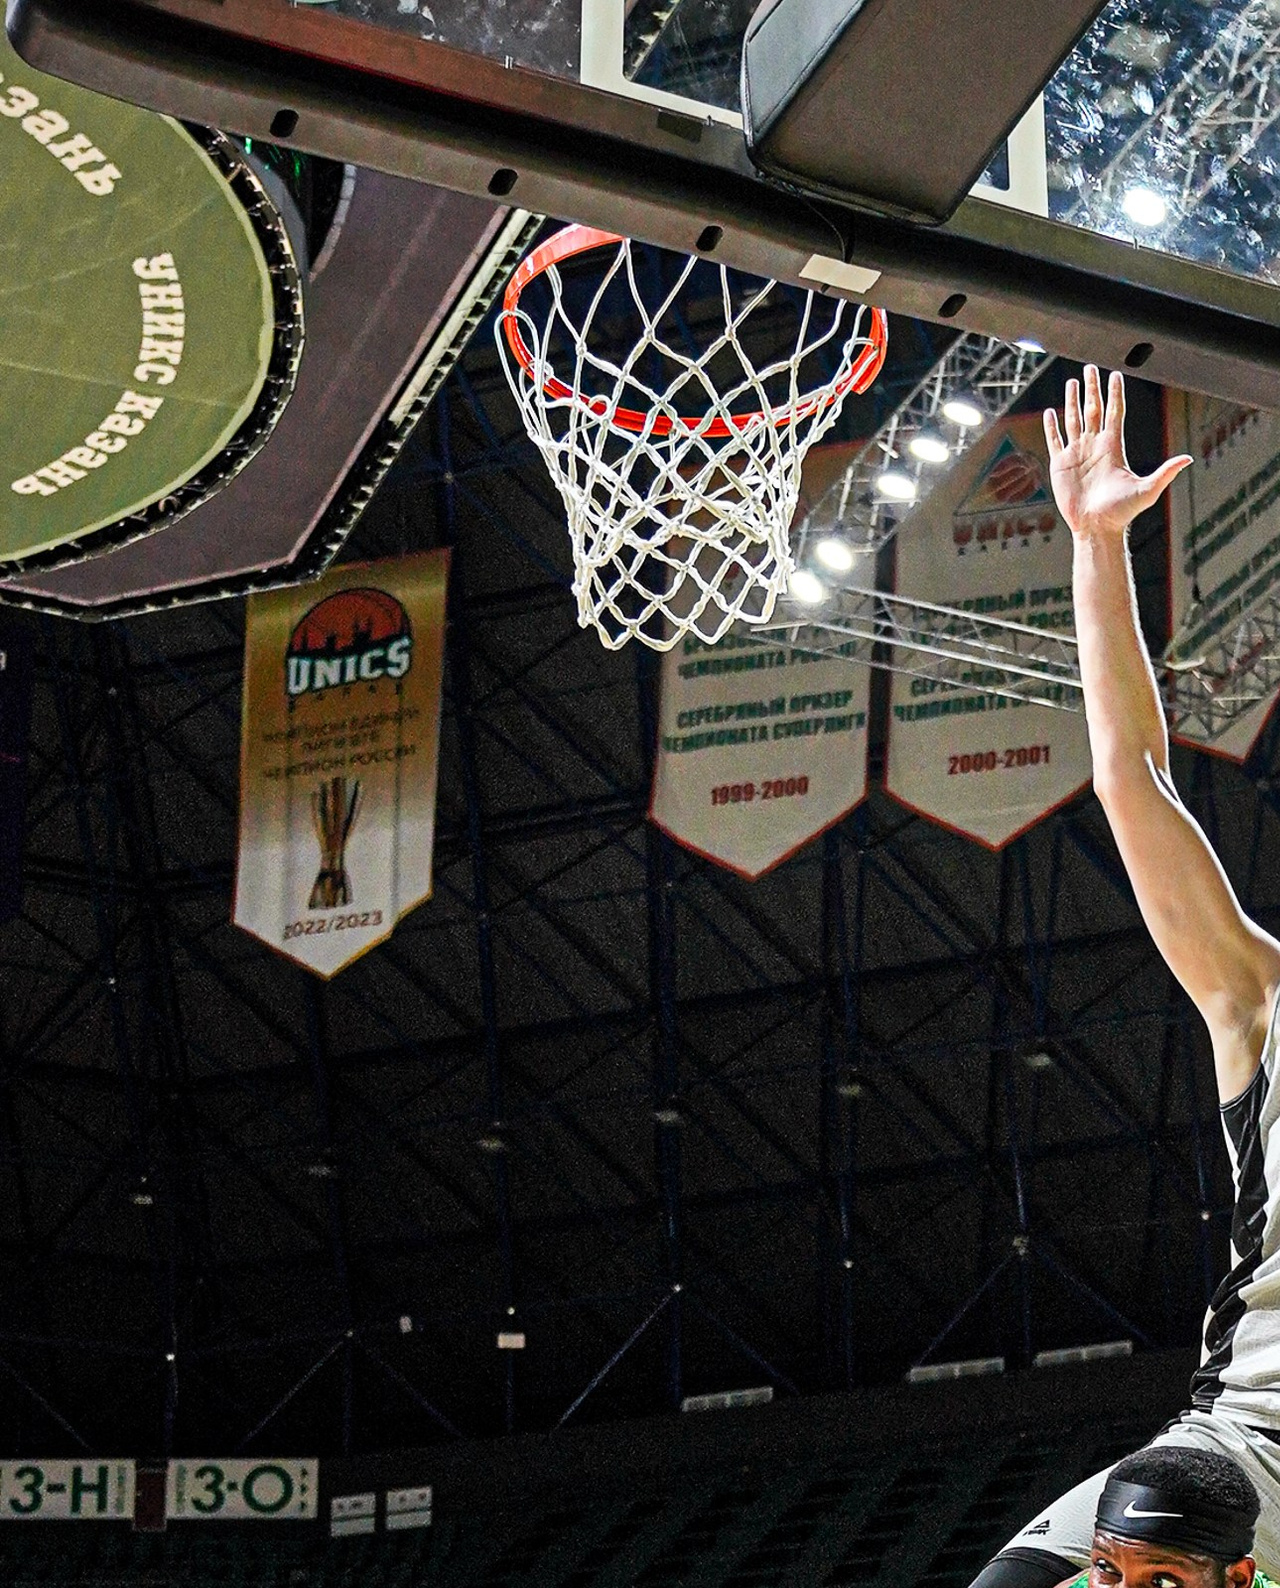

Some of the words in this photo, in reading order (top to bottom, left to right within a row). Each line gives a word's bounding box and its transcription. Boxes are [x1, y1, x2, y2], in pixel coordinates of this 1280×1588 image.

[0, 73, 122, 196] зань
[133, 252, 186, 386] УНИКС
[288, 639, 411, 695] UNICS
[949, 745, 1051, 776] 2000-2001
[711, 775, 810, 807] 1999-2000
[283, 908, 383, 940] 2022/2023
[10, 1465, 109, 1514] 3-Н
[191, 1465, 294, 1514] 3-О
